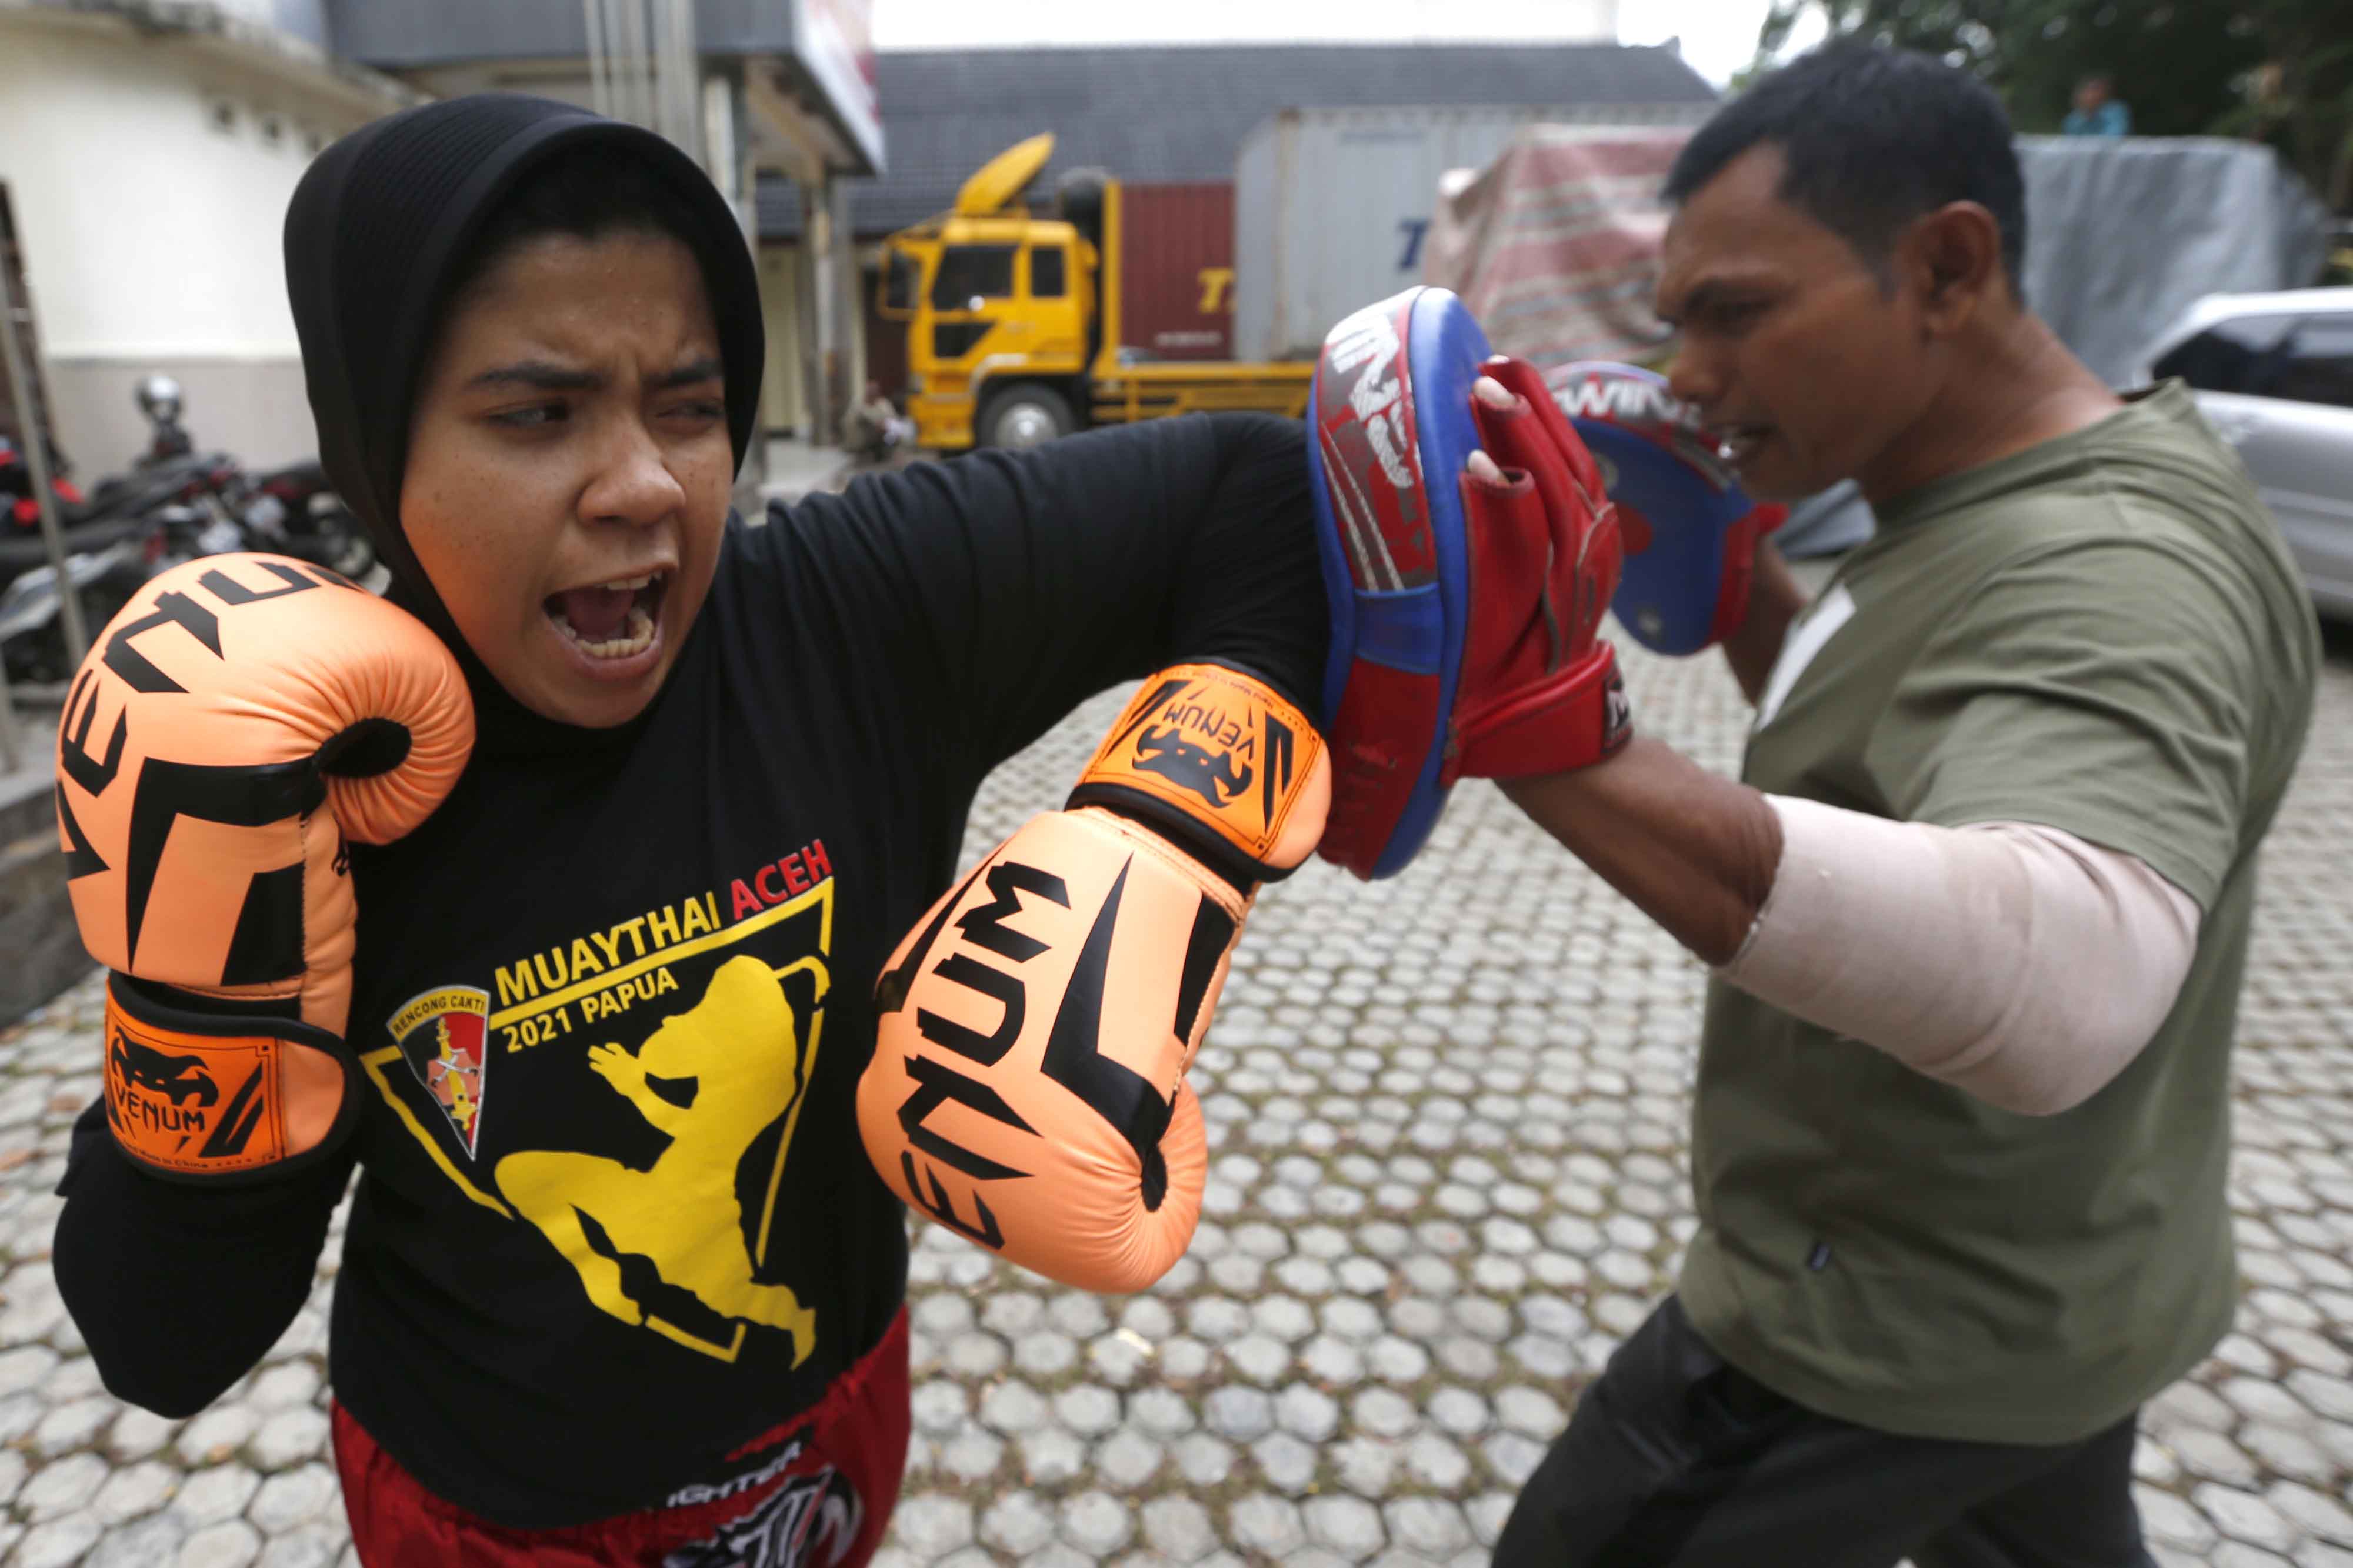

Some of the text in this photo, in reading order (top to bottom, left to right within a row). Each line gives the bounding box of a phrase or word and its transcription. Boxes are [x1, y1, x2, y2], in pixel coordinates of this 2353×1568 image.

[1553, 379, 1702, 431] WIN
[1163, 703, 1255, 761] VENUM
[494, 839, 833, 1007] MUAYTHAI ACEH
[392, 997, 446, 1035] RENCONG
[503, 967, 679, 1053] 2021 PAPUA
[896, 860, 1071, 1250] ENUM
[115, 1080, 205, 1135] VENUM
